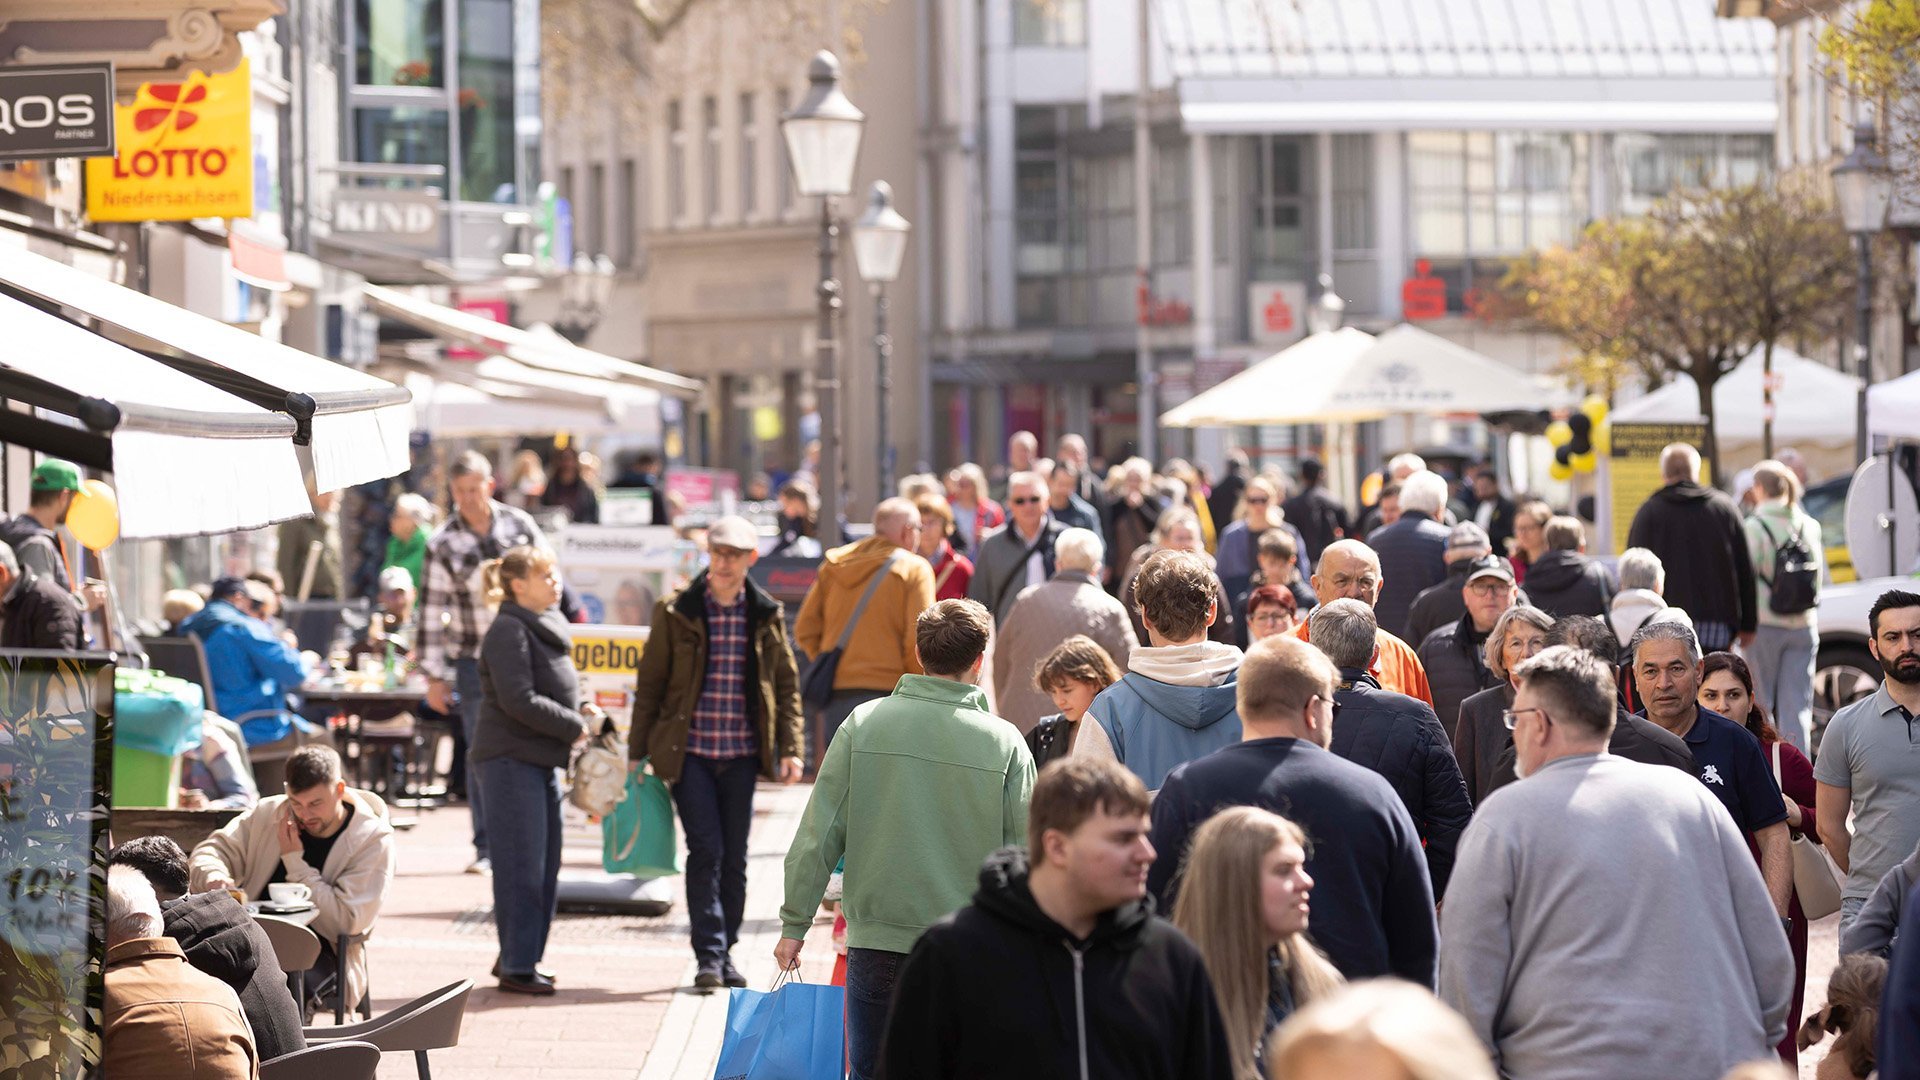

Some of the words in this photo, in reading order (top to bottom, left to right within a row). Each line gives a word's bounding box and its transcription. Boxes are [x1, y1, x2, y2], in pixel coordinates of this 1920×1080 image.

[54, 128, 95, 140] PARTNER
[113, 148, 228, 179] LOTTO
[103, 188, 240, 208] Niedersachsen
[335, 201, 435, 234] KIND
[568, 640, 641, 671] gebo
